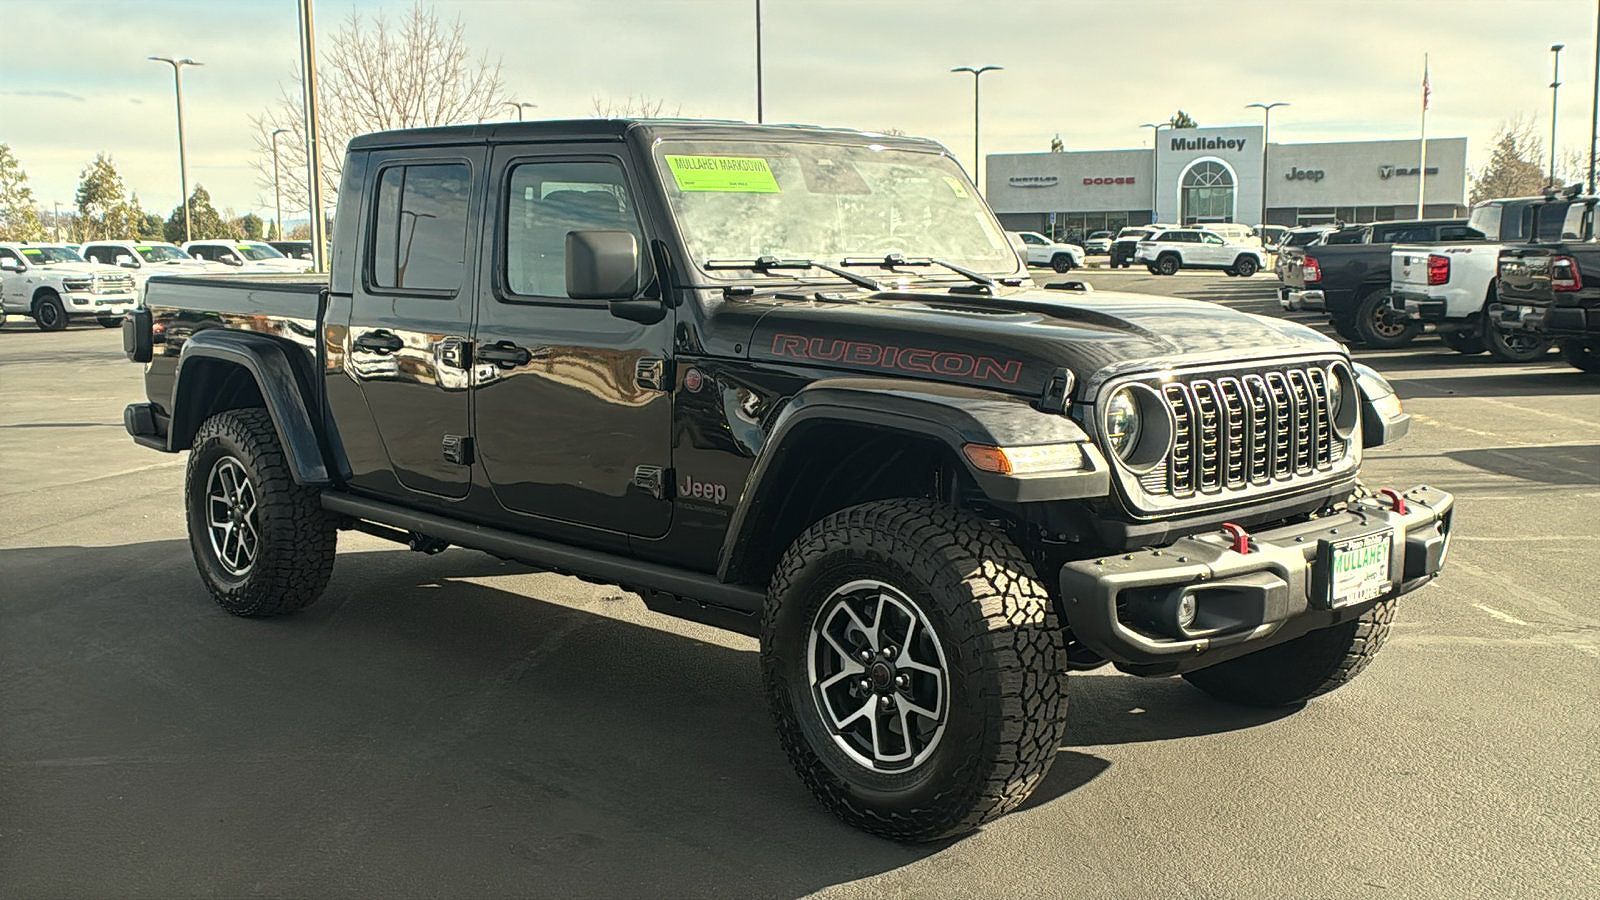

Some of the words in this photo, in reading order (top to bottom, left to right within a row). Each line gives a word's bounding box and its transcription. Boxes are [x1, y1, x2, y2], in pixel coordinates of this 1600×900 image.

[1171, 137, 1246, 152] Mullahey
[674, 158, 718, 171] MULLAHEY
[720, 159, 767, 172] MARKDOWN
[1083, 177, 1136, 186] DODGE
[1285, 166, 1324, 183] Jeep
[771, 333, 1023, 384] RUBICON
[680, 475, 727, 505] Jeep
[1335, 543, 1388, 574] MULLAHEY
